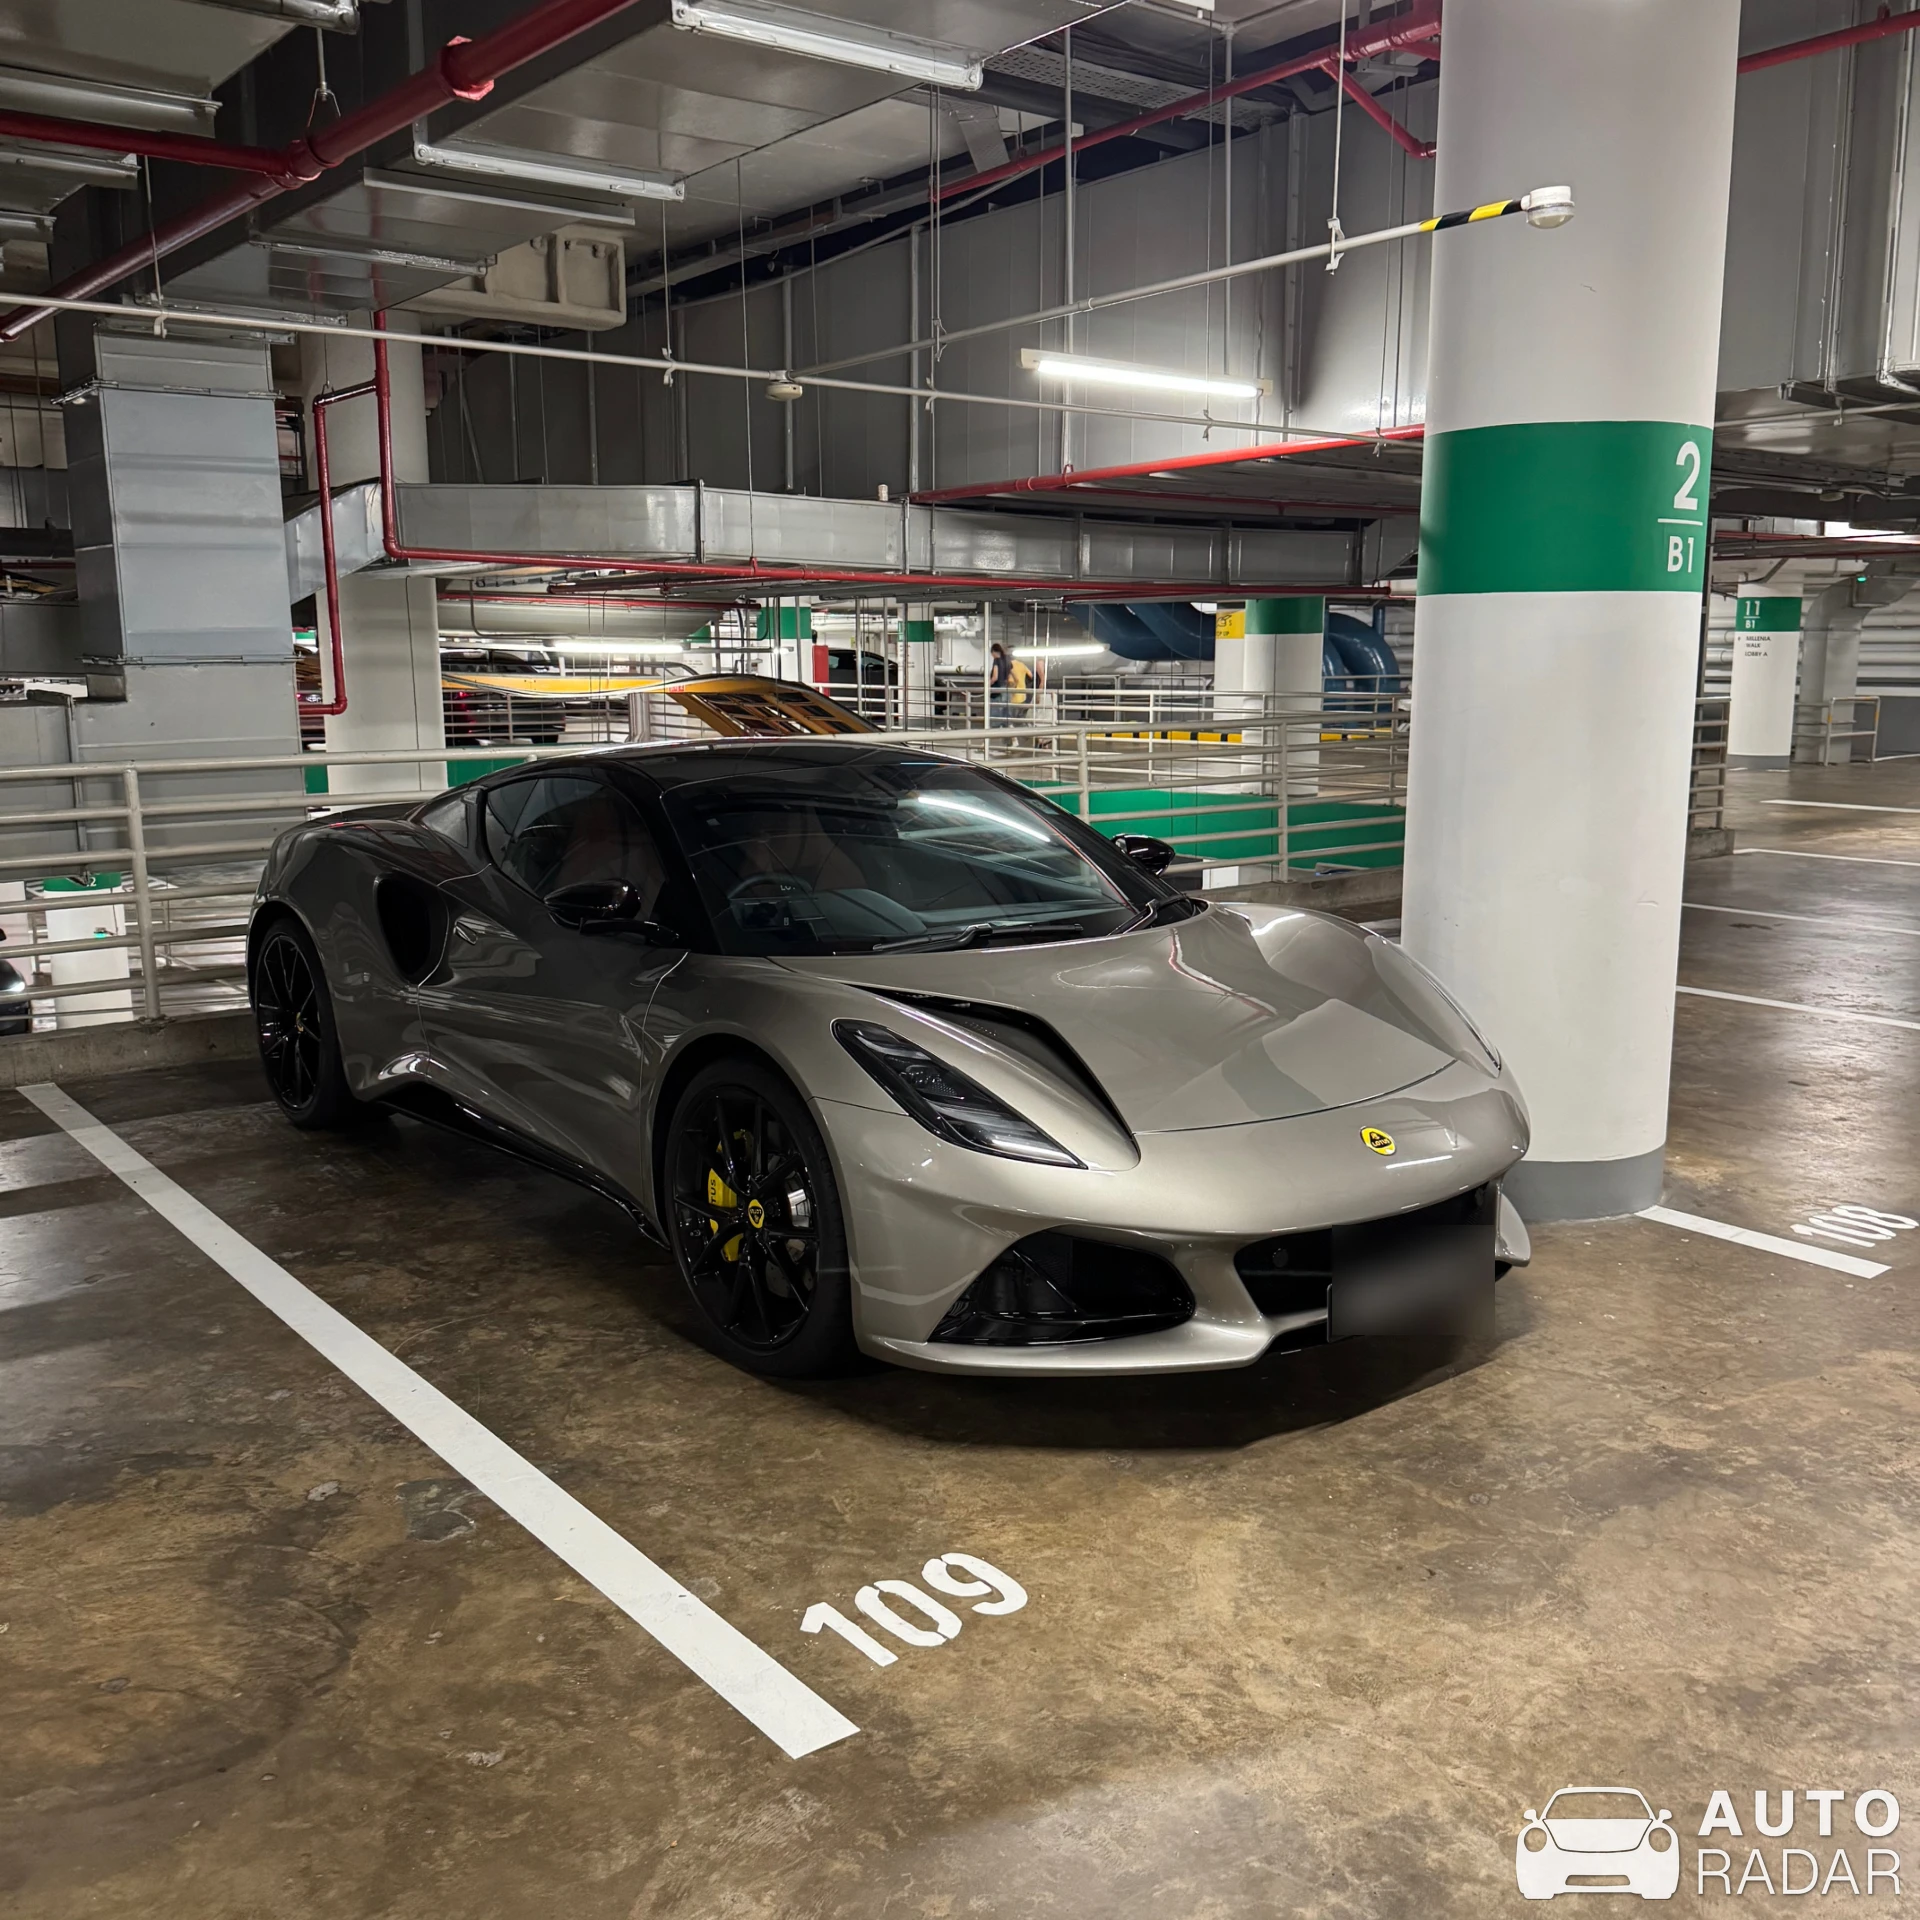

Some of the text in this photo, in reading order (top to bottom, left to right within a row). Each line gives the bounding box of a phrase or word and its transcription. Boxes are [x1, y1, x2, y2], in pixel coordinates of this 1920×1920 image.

[1673, 441, 1701, 510] 2
[1667, 535, 1695, 573] B1
[1745, 600, 1761, 616] 11
[1745, 619, 1756, 629] B1
[709, 1179, 717, 1204] TUS
[1789, 1204, 1920, 1248] 108
[800, 1552, 1028, 1667] 109
